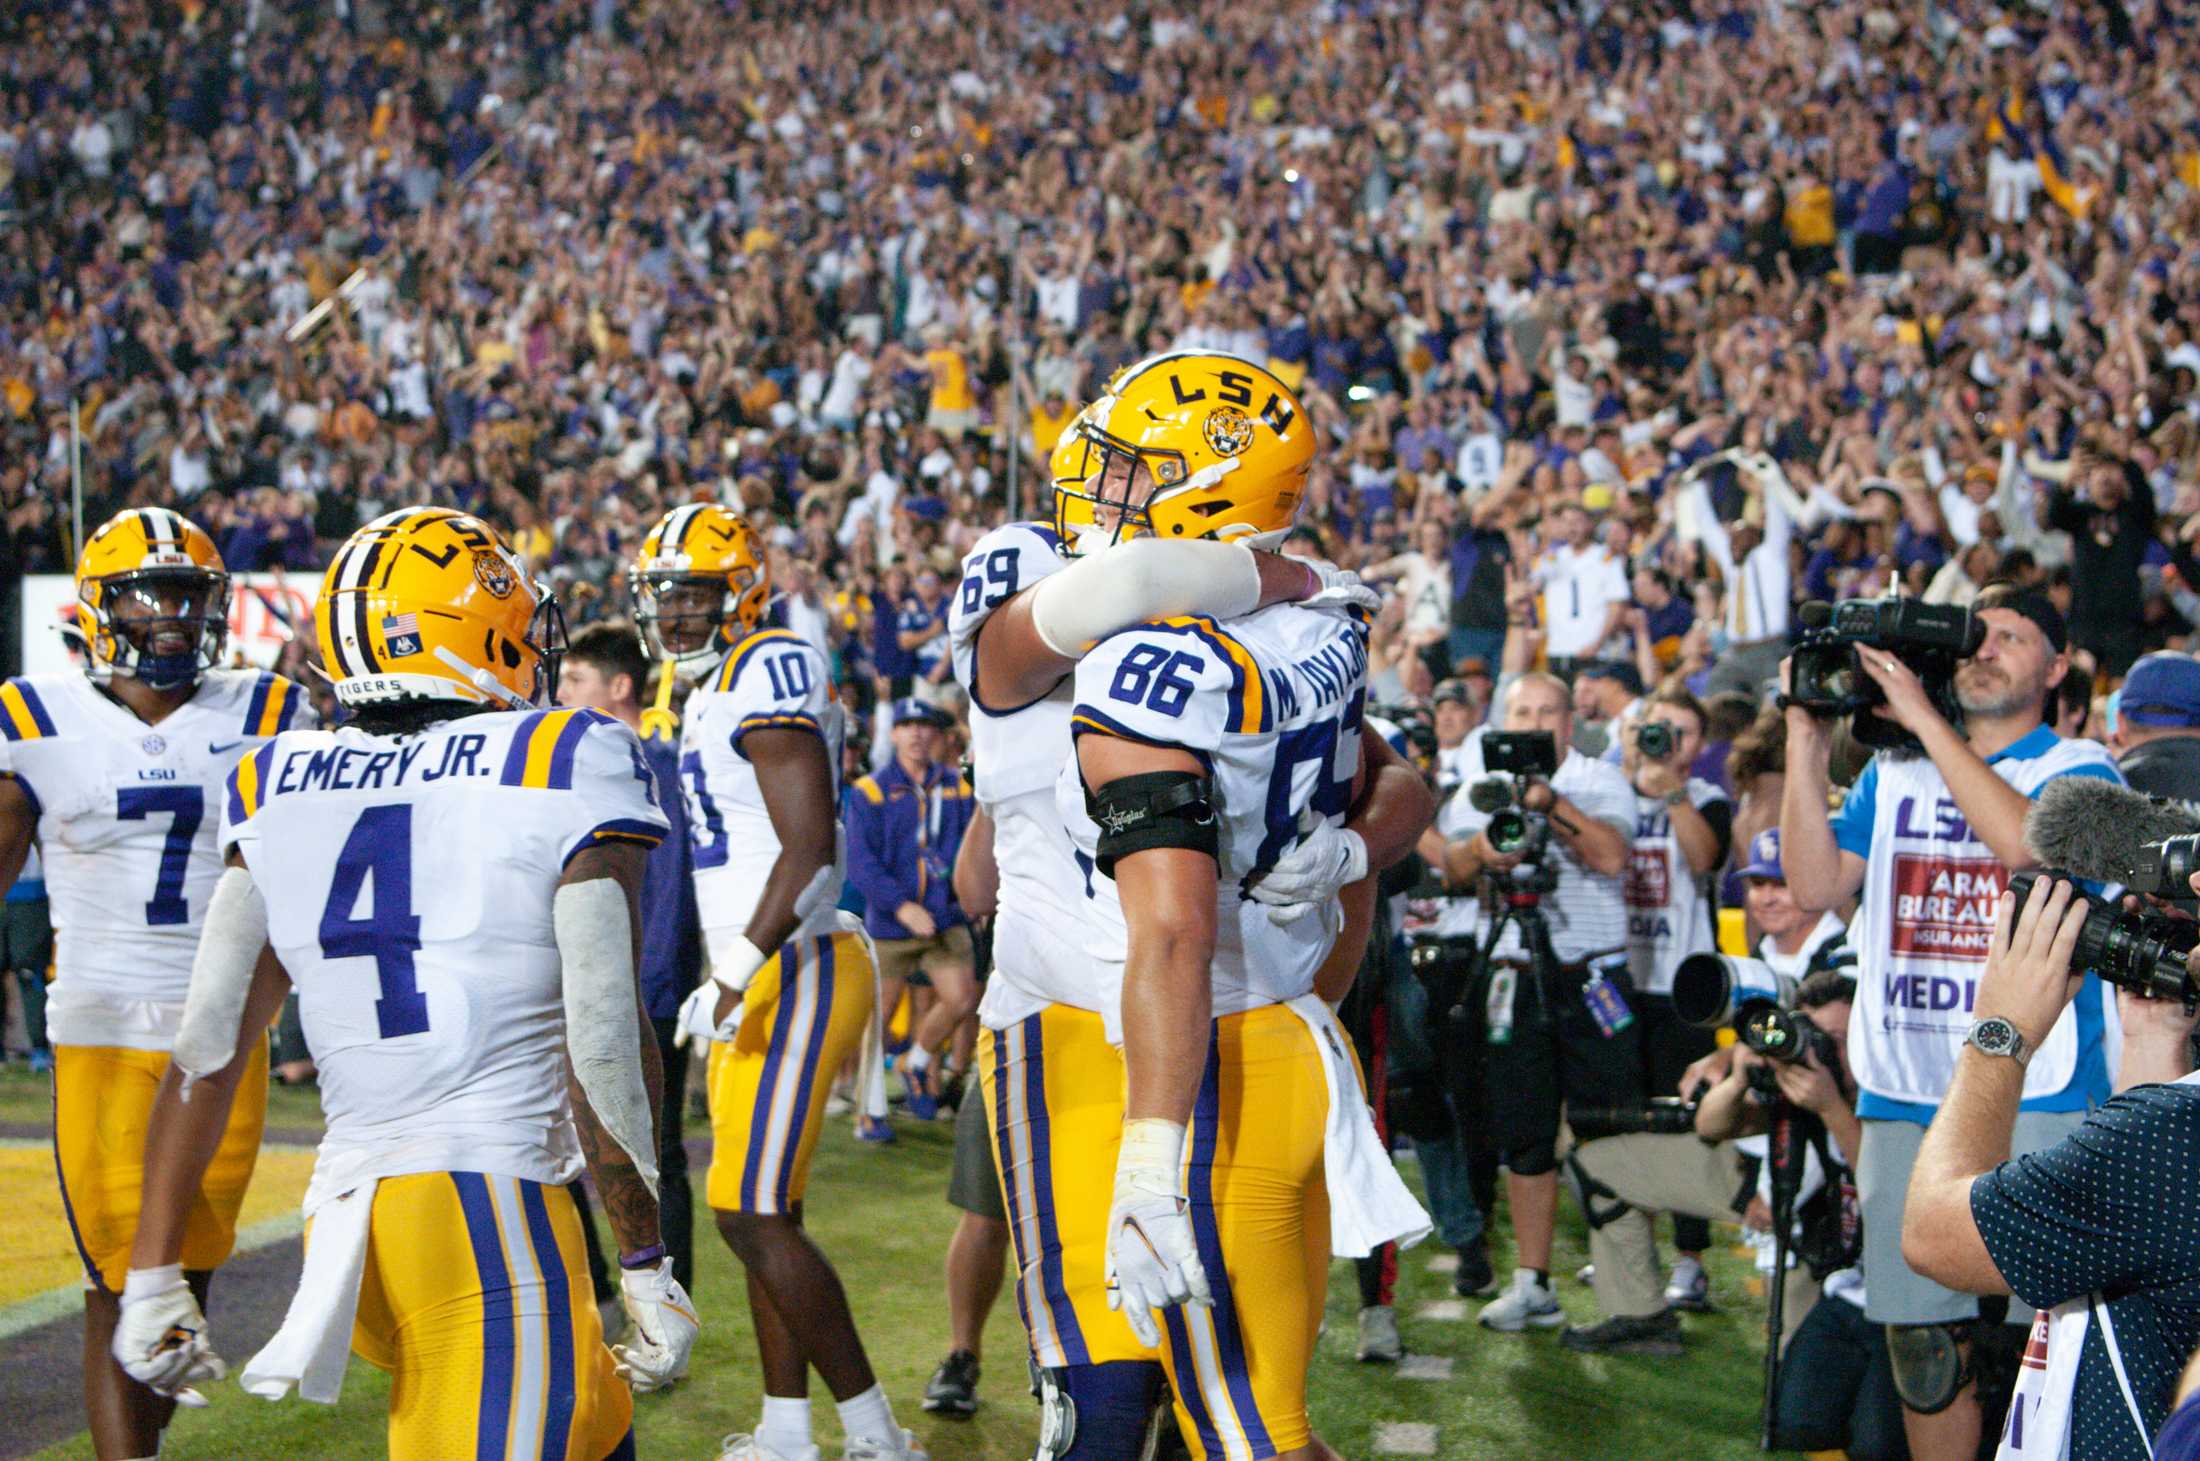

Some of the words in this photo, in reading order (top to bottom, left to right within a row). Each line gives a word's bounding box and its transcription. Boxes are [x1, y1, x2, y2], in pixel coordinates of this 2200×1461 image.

[1169, 370, 1297, 437] LSU
[409, 520, 515, 570] LS
[962, 547, 1021, 616] 69
[340, 679, 402, 696] TIGERS
[764, 651, 811, 701] 10
[1108, 642, 1206, 719] 86
[1269, 668, 1300, 722] M.
[138, 768, 176, 780] LSU
[276, 742, 425, 795] EMERY
[422, 734, 490, 782] JR.
[1895, 797, 1981, 843] LS
[116, 785, 205, 926] 7
[1931, 869, 2000, 897] ARM
[319, 803, 430, 1039] 4
[1913, 929, 1994, 949] NSURANC
[1885, 973, 1975, 1013] MEDI
